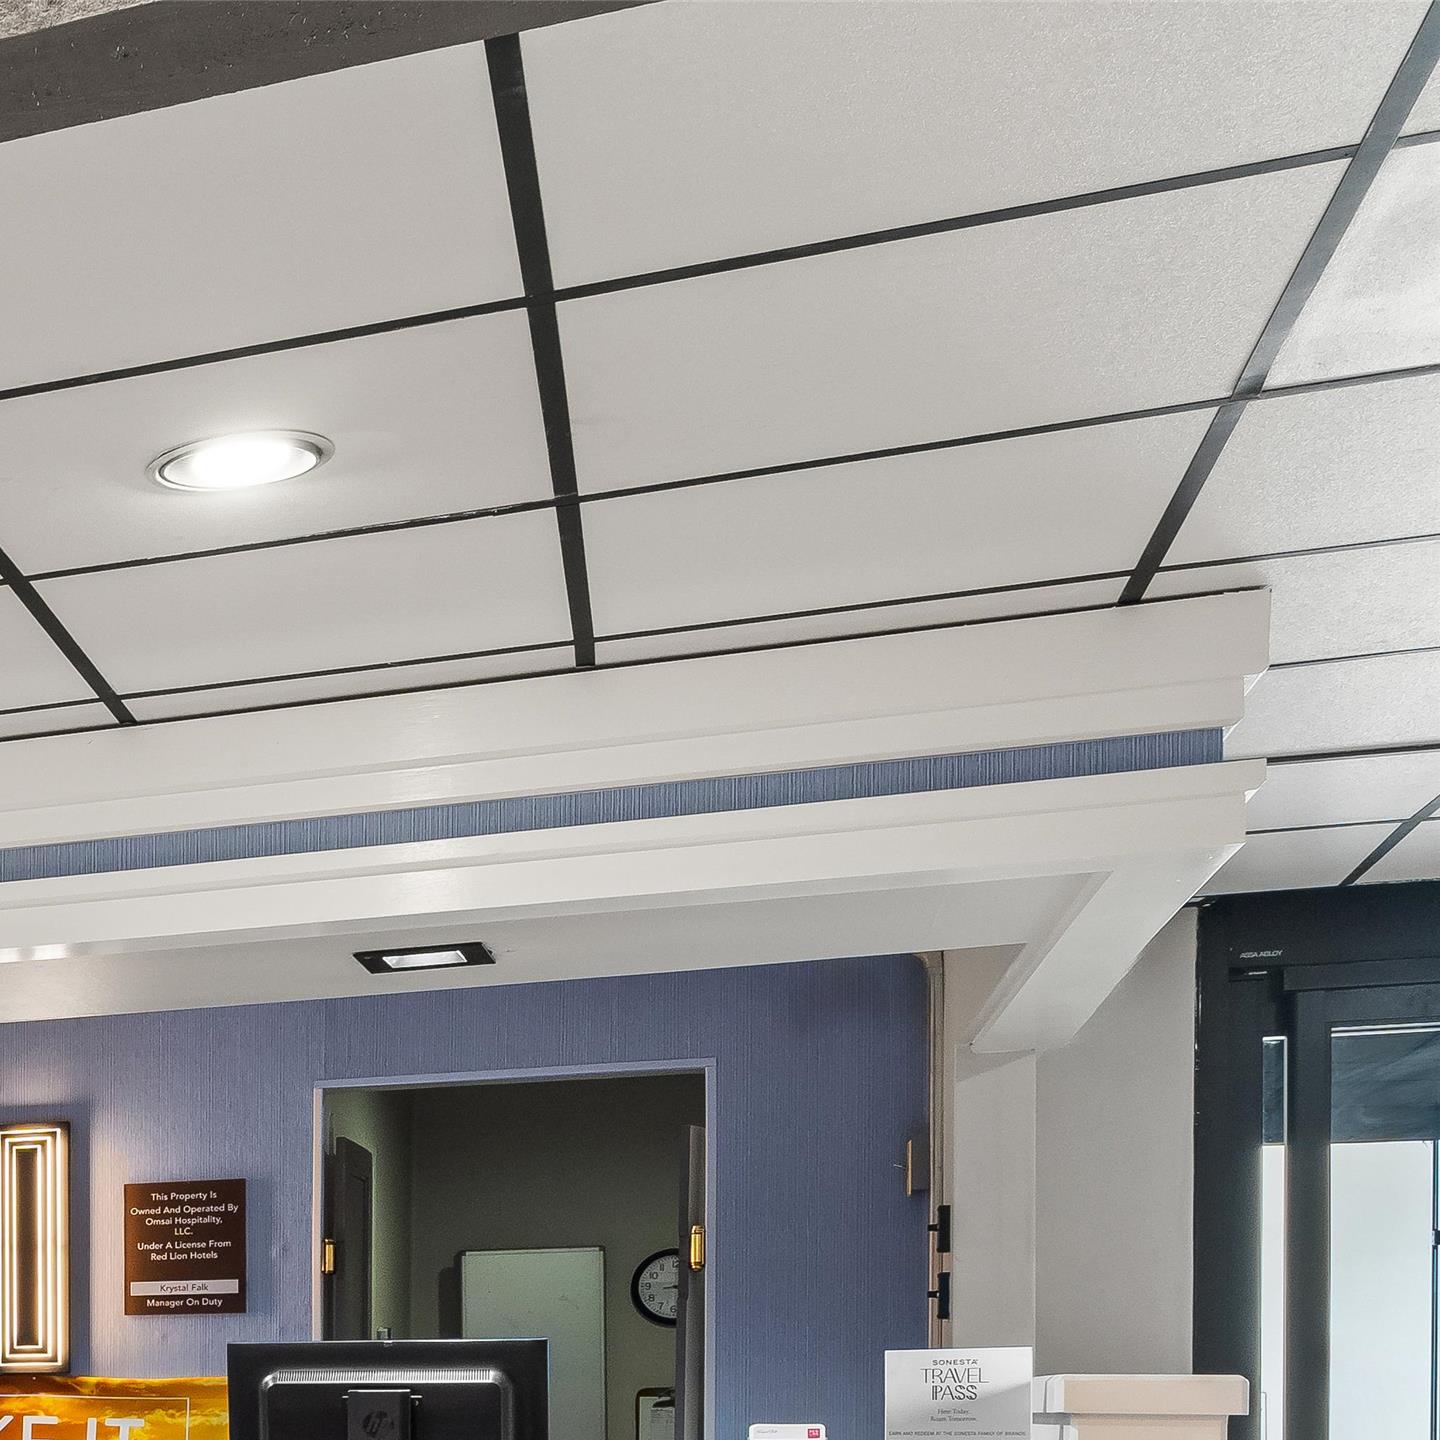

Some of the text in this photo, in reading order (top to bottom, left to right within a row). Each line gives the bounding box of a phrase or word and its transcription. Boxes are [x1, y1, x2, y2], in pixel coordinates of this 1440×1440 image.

[150, 1191, 217, 1202] This Property Is
[130, 1203, 239, 1216] Owned And Operated By
[145, 1217, 173, 1226] Omsai
[137, 1239, 232, 1251] Under A License From
[150, 1250, 218, 1261] Red Lion Hotels
[160, 1283, 189, 1293] Krystal
[645, 1282, 652, 1290] 9
[146, 1298, 184, 1308] Manager
[201, 1297, 223, 1307] Duty
[920, 1367, 990, 1384] TRAVEL
[931, 1384, 978, 1401] PASS
